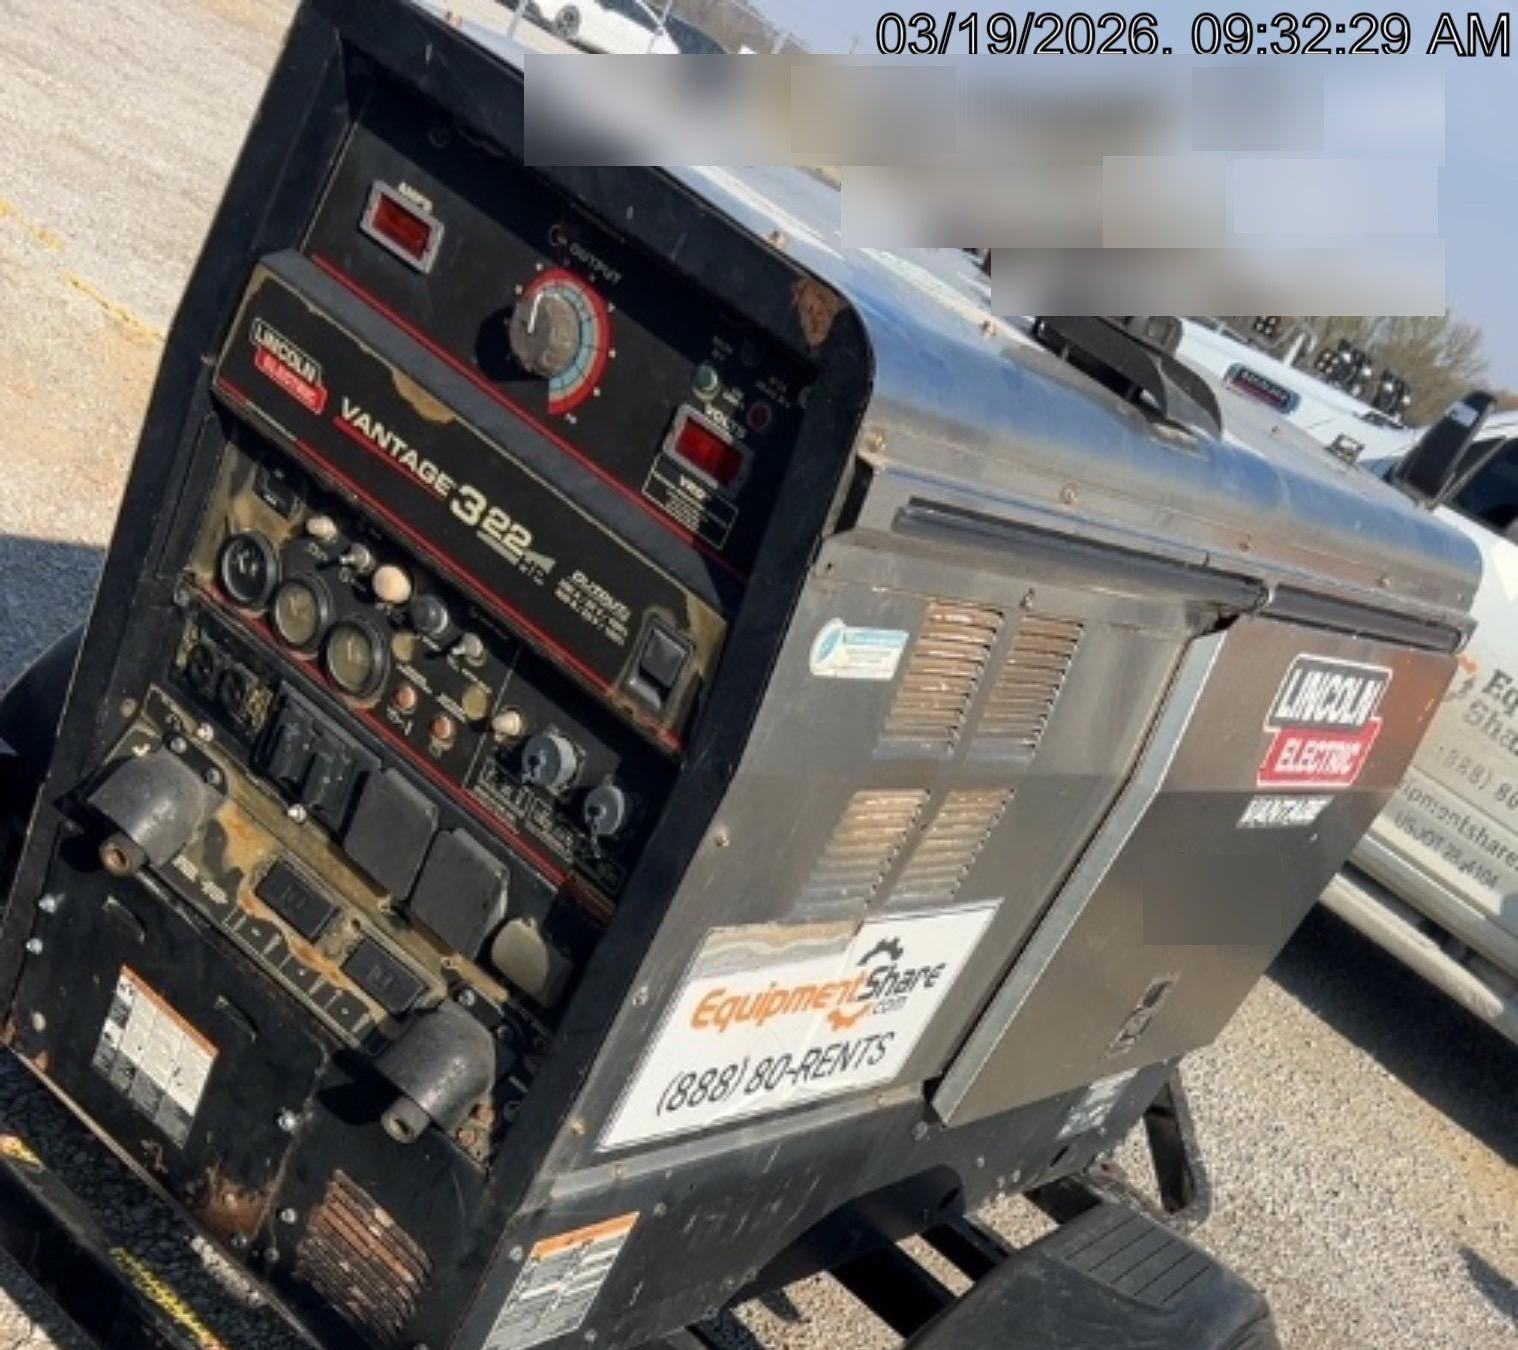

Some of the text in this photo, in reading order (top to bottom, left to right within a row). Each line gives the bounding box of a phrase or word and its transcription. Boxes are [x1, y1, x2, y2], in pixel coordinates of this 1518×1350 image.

[340, 395, 534, 557] VANTAGE 322
[1273, 667, 1385, 727] LINCOLN
[1273, 737, 1364, 775] ELECTRIC
[656, 1031, 896, 1117] (888) 80-RENTS
